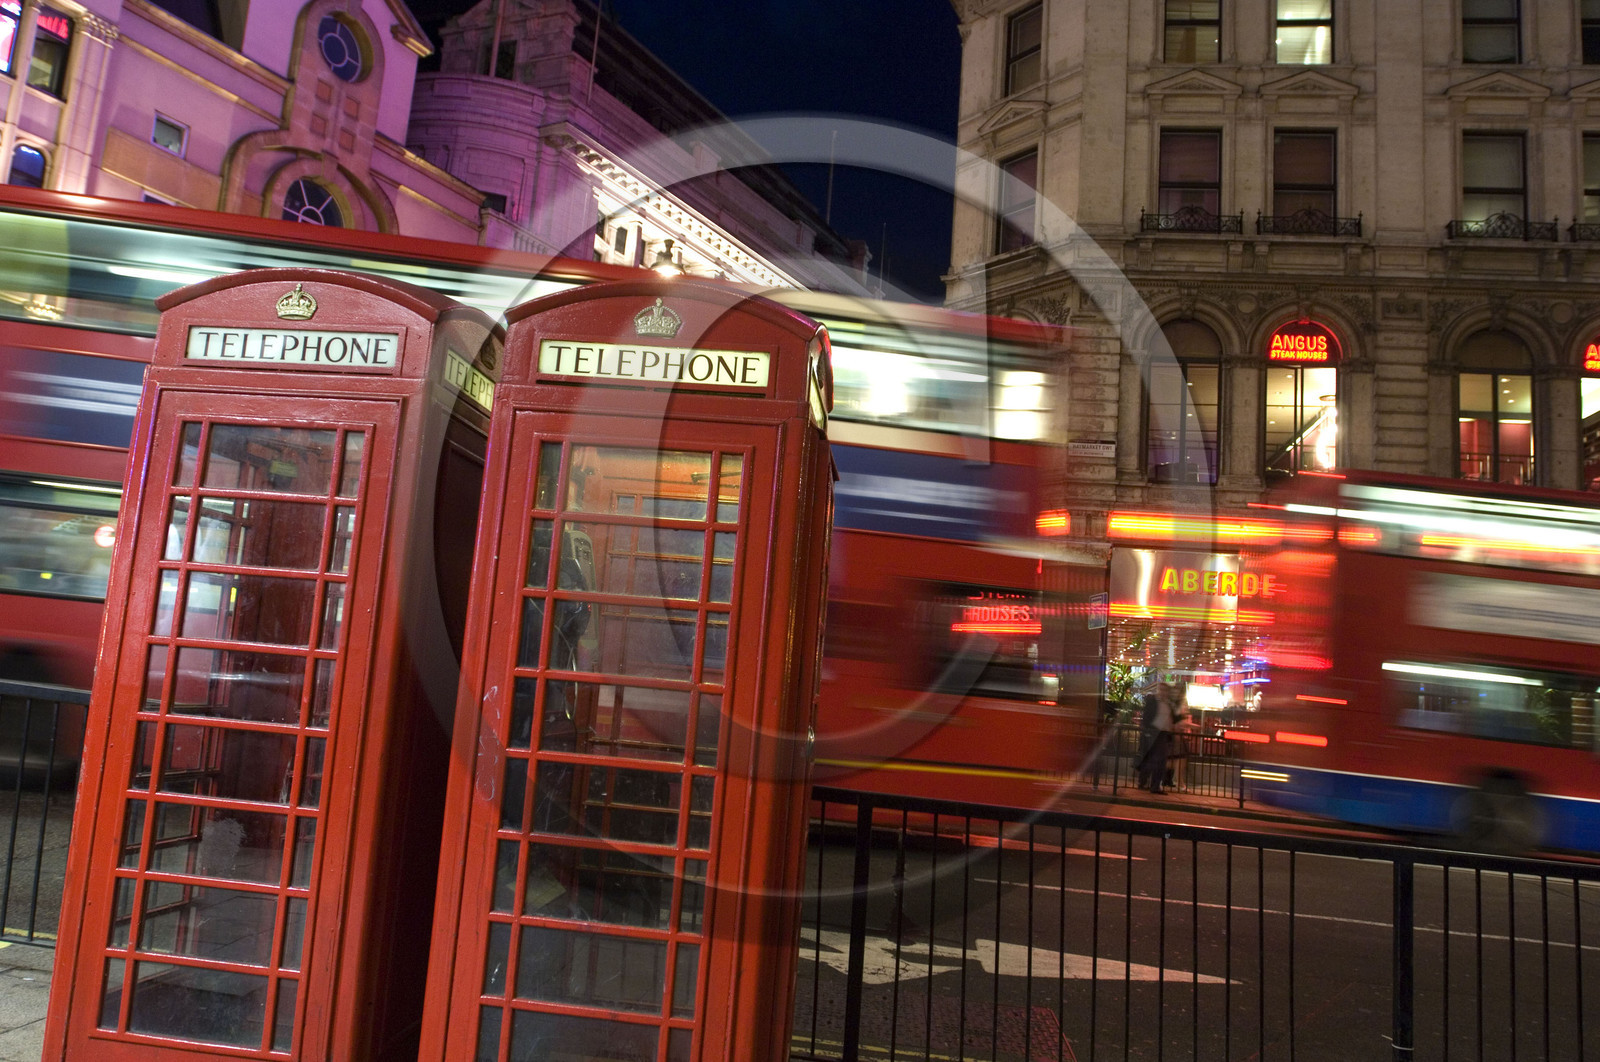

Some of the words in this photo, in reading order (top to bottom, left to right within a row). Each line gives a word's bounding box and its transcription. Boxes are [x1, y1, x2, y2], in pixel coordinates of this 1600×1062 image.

[199, 332, 391, 364] TELEPHONE
[1271, 334, 1328, 350] ANGUS
[1271, 350, 1295, 359] STEAK
[1296, 351, 1328, 361] HOUSES
[1585, 343, 1600, 360] A
[549, 346, 760, 384] TELEPHONE
